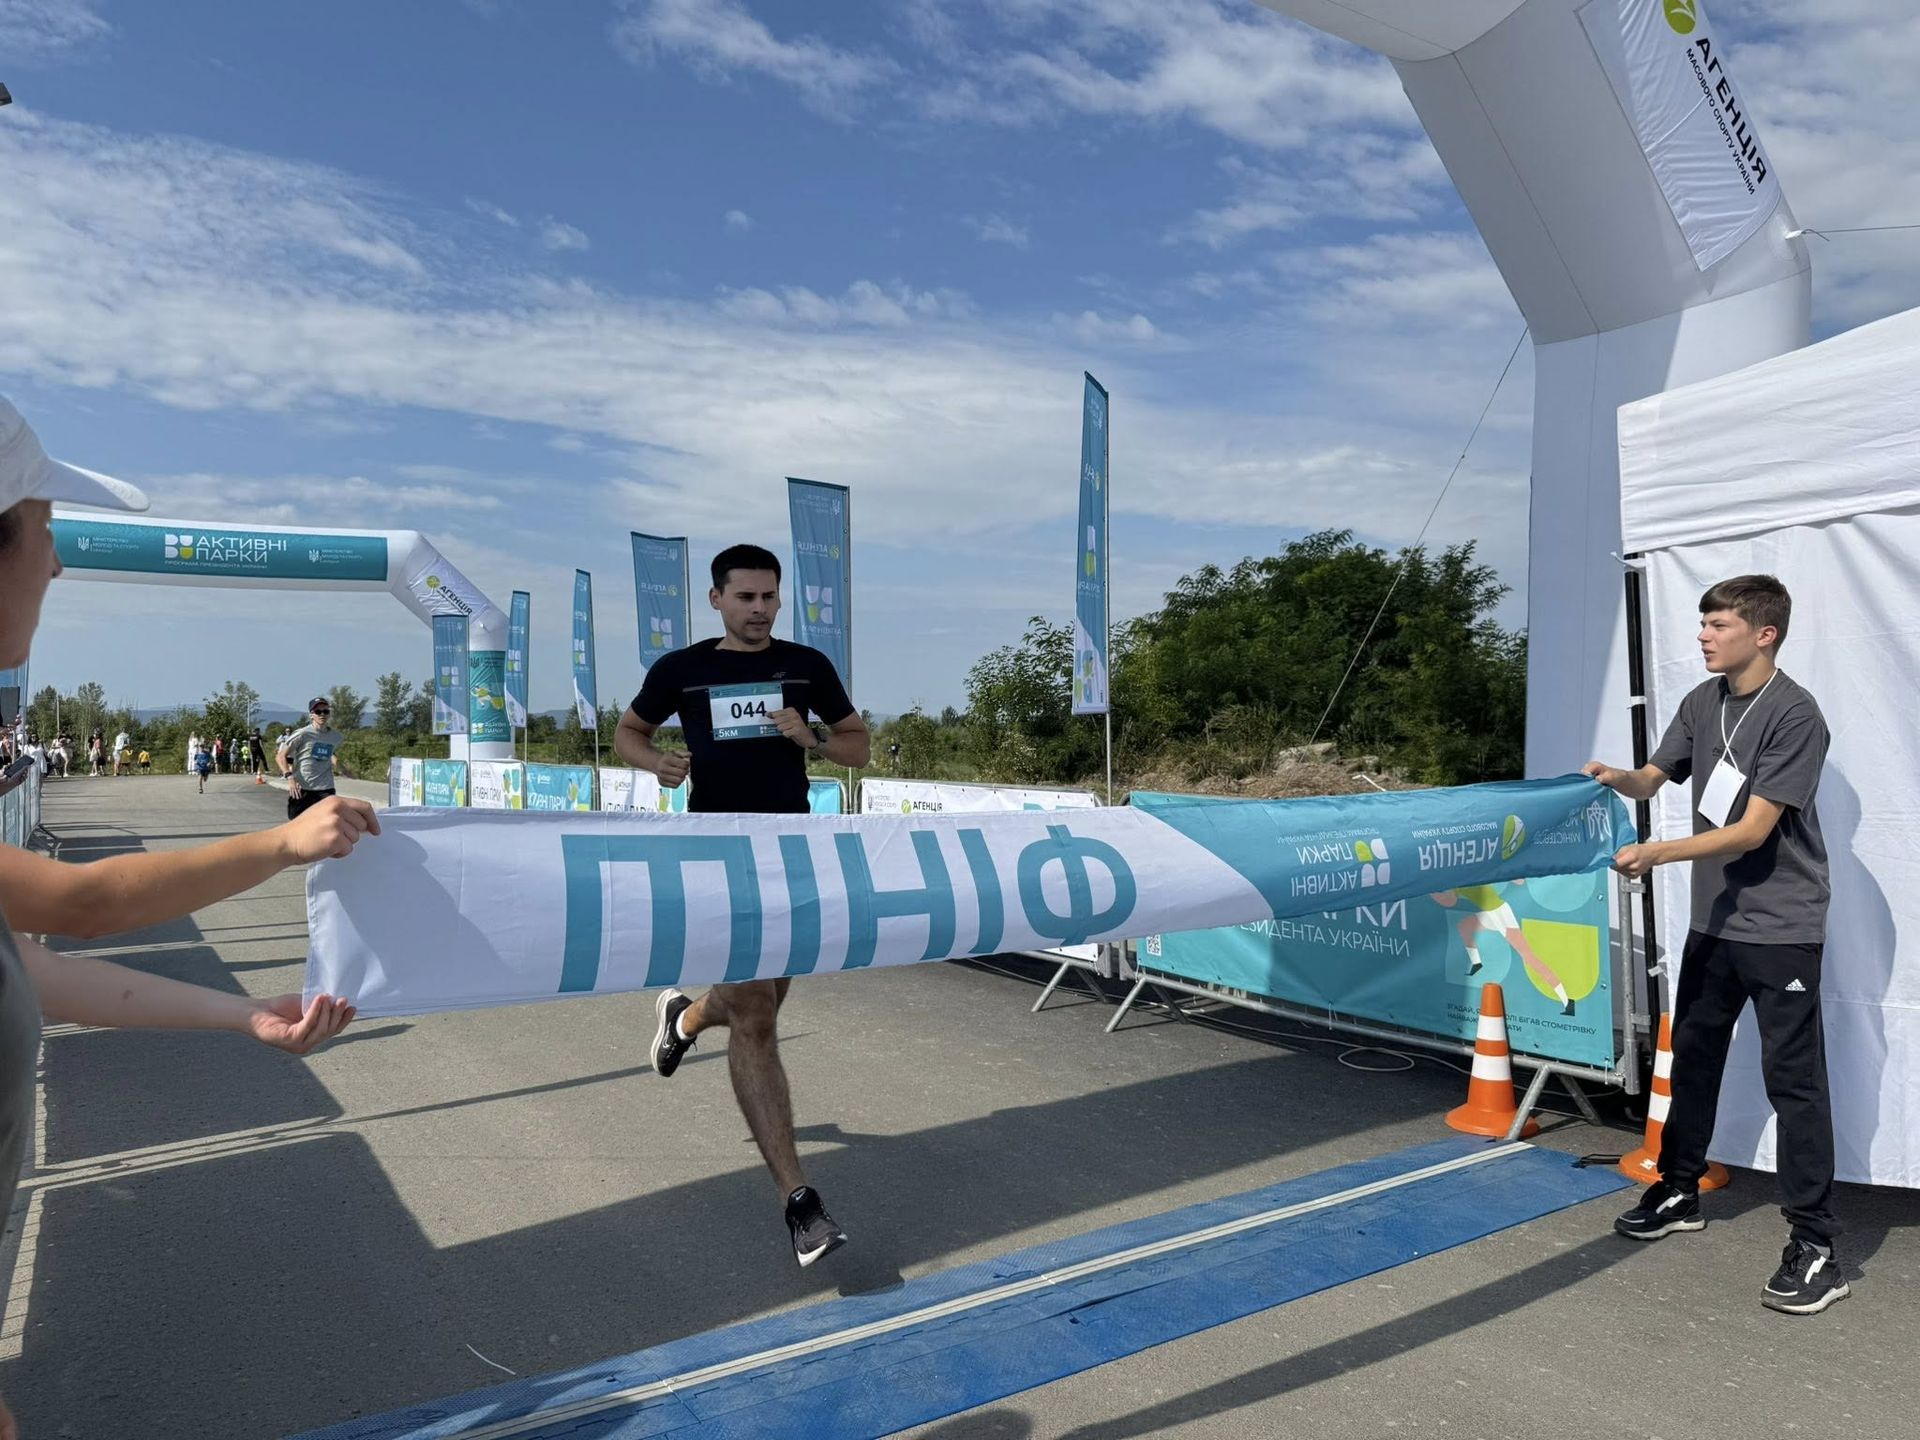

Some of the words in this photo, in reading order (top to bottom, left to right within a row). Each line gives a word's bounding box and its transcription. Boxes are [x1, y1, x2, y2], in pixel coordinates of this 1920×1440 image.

[1696, 37, 1767, 185] АГЕНЦІЯ
[1686, 48, 1716, 108] МАСОВОГО
[1713, 108, 1735, 150] СПОРТУ
[1732, 149, 1756, 196] УКРАЇНИ
[196, 535, 287, 552] АКТИВНІ
[196, 548, 268, 563] ПАРКИ
[440, 585, 473, 615] АГЕНЦІЯ
[731, 700, 767, 719] 044
[913, 801, 943, 812] АГЕНЦІЯ
[1411, 826, 1442, 839] УКРАЇНИ
[1444, 824, 1466, 835] СПОРТУ
[1465, 821, 1498, 833] МАСОВОГО
[1296, 842, 1354, 865] ПАРКИ
[1418, 837, 1499, 871] АГЕНЦІЯ
[1291, 870, 1358, 897] АКТИВНІ
[559, 824, 1138, 992] ФІНІШ
[1330, 928, 1410, 957] УКРАЇНИ
[1541, 1020, 1597, 1035] СТОМЕТРІВКУ
